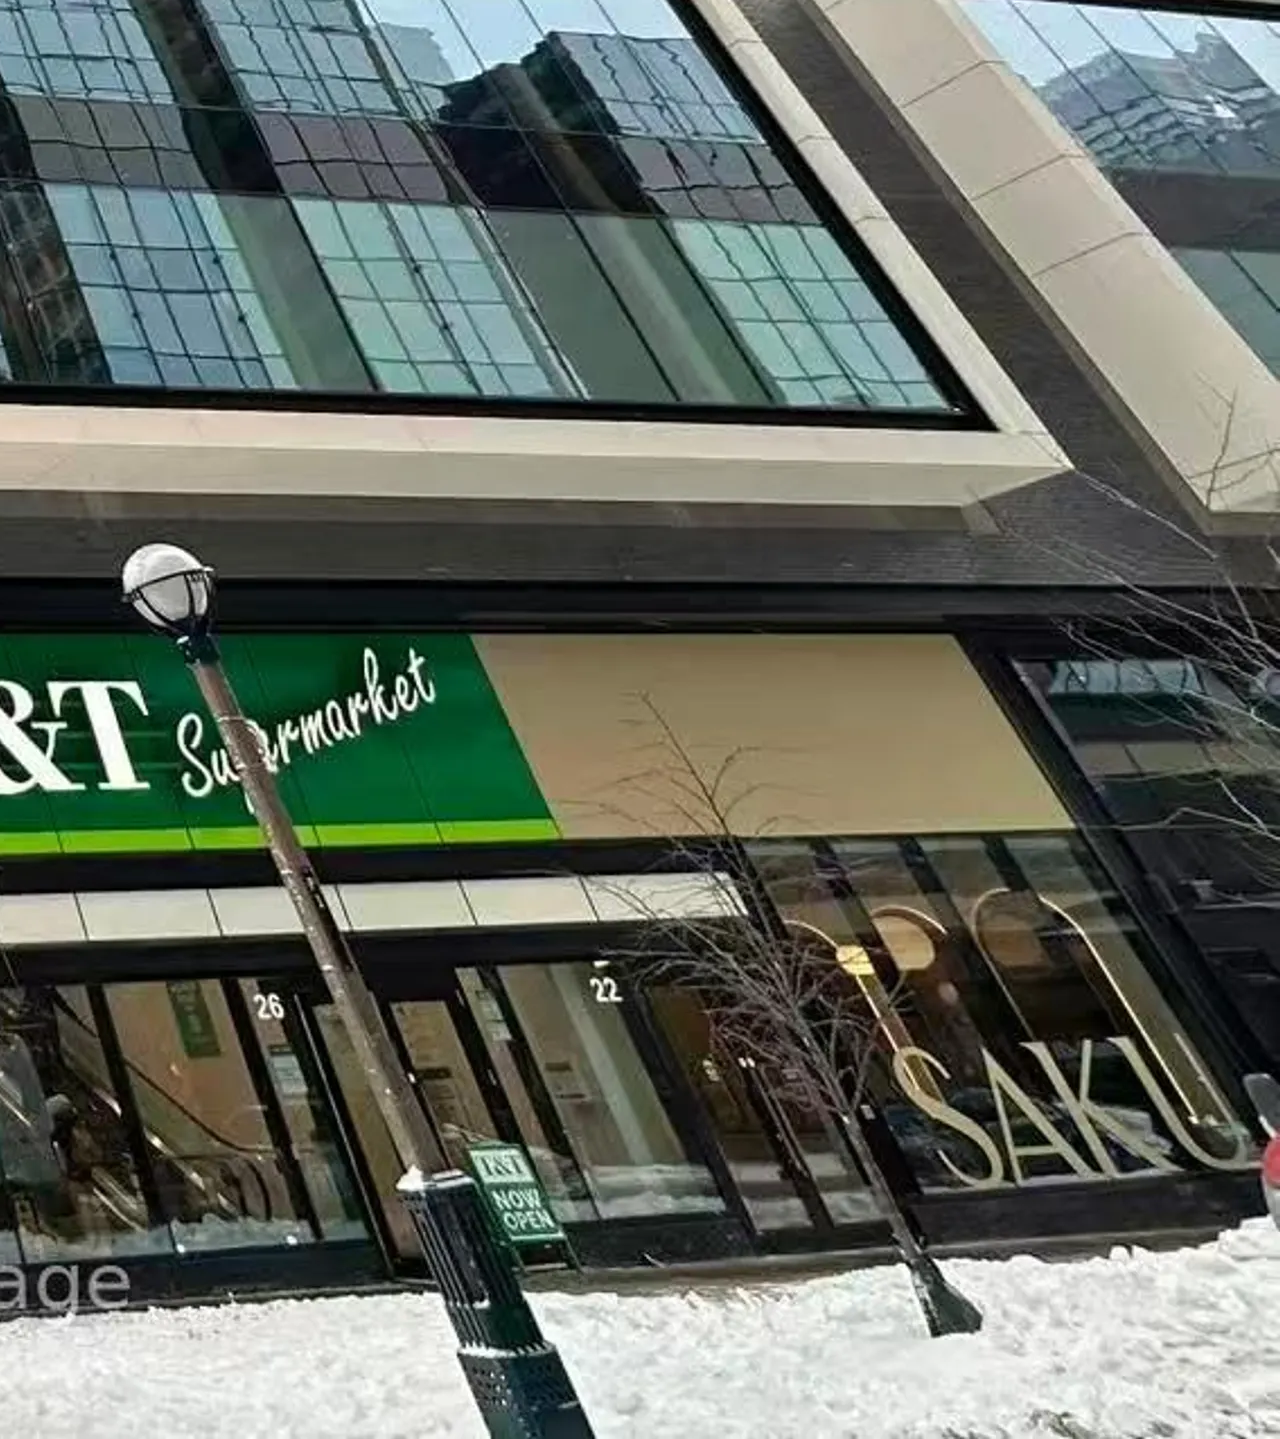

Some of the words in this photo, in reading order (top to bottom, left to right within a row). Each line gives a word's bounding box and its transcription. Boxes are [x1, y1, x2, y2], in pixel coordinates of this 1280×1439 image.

[176, 646, 436, 815] Suermarket
[588, 976, 623, 1005] 22
[253, 991, 285, 1021] 26
[892, 1033, 1256, 1188] SAKU
[474, 1154, 525, 1177] T&T
[491, 1187, 542, 1211] NOW
[503, 1208, 556, 1231] OPEN
